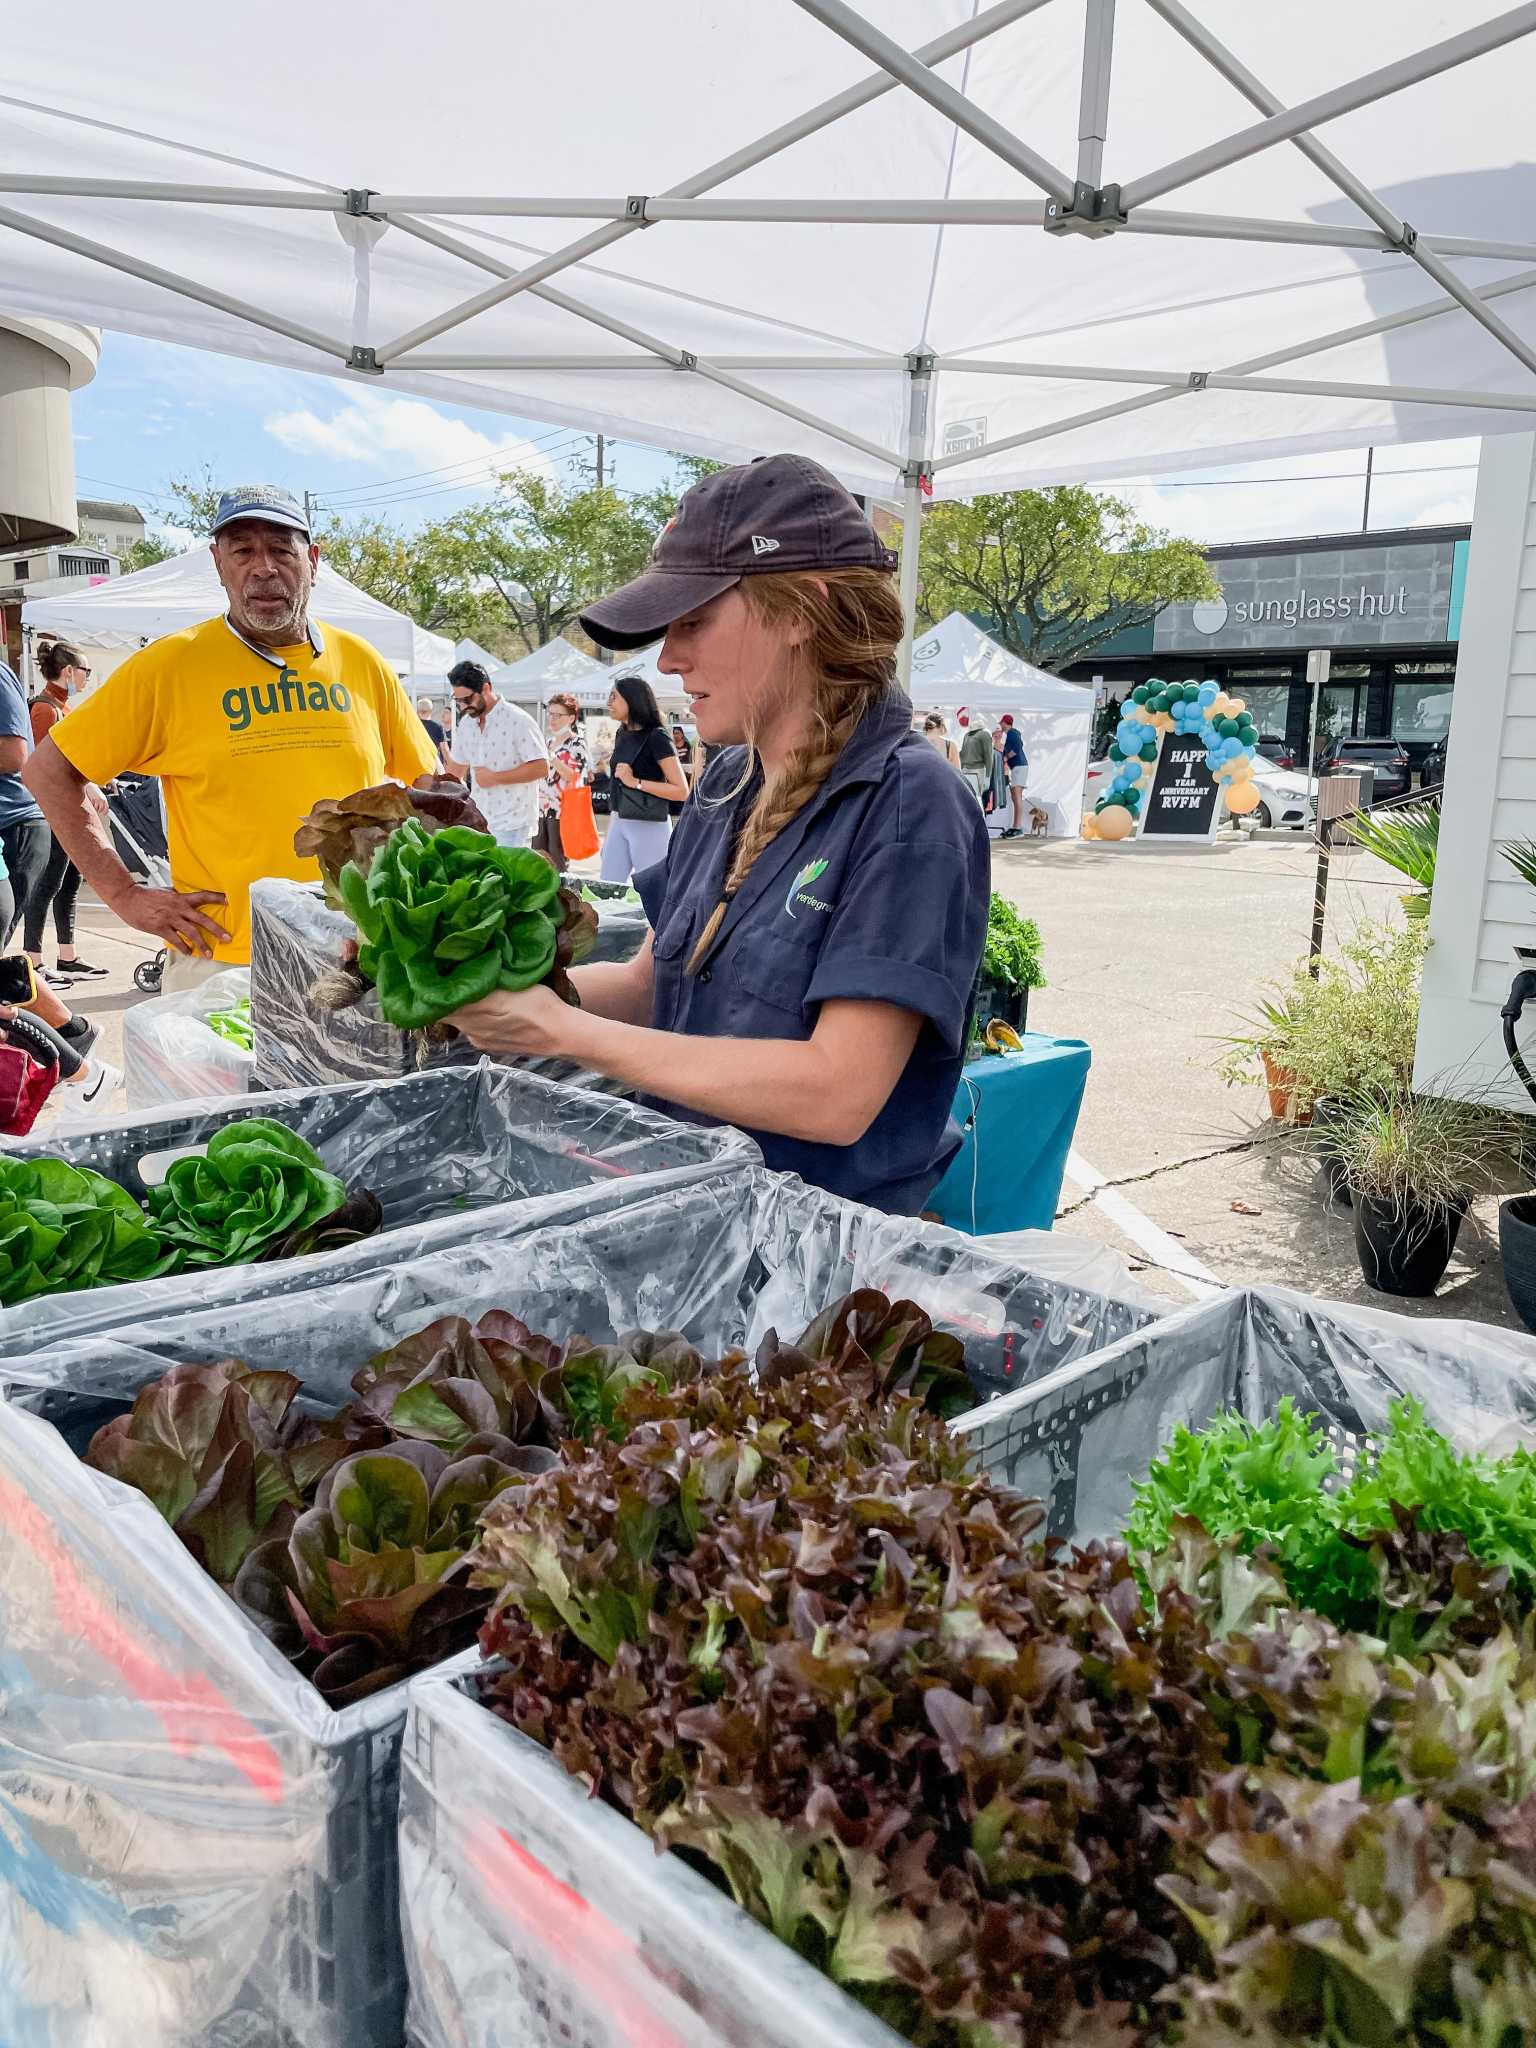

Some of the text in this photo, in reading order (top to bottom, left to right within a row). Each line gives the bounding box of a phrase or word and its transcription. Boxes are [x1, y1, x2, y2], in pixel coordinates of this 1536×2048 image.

[1235, 584, 1408, 628] sunglass hut
[1175, 778, 1197, 787] YEAR
[1159, 786, 1210, 796] ANNIVERSARY
[1161, 795, 1201, 809] RVFM
